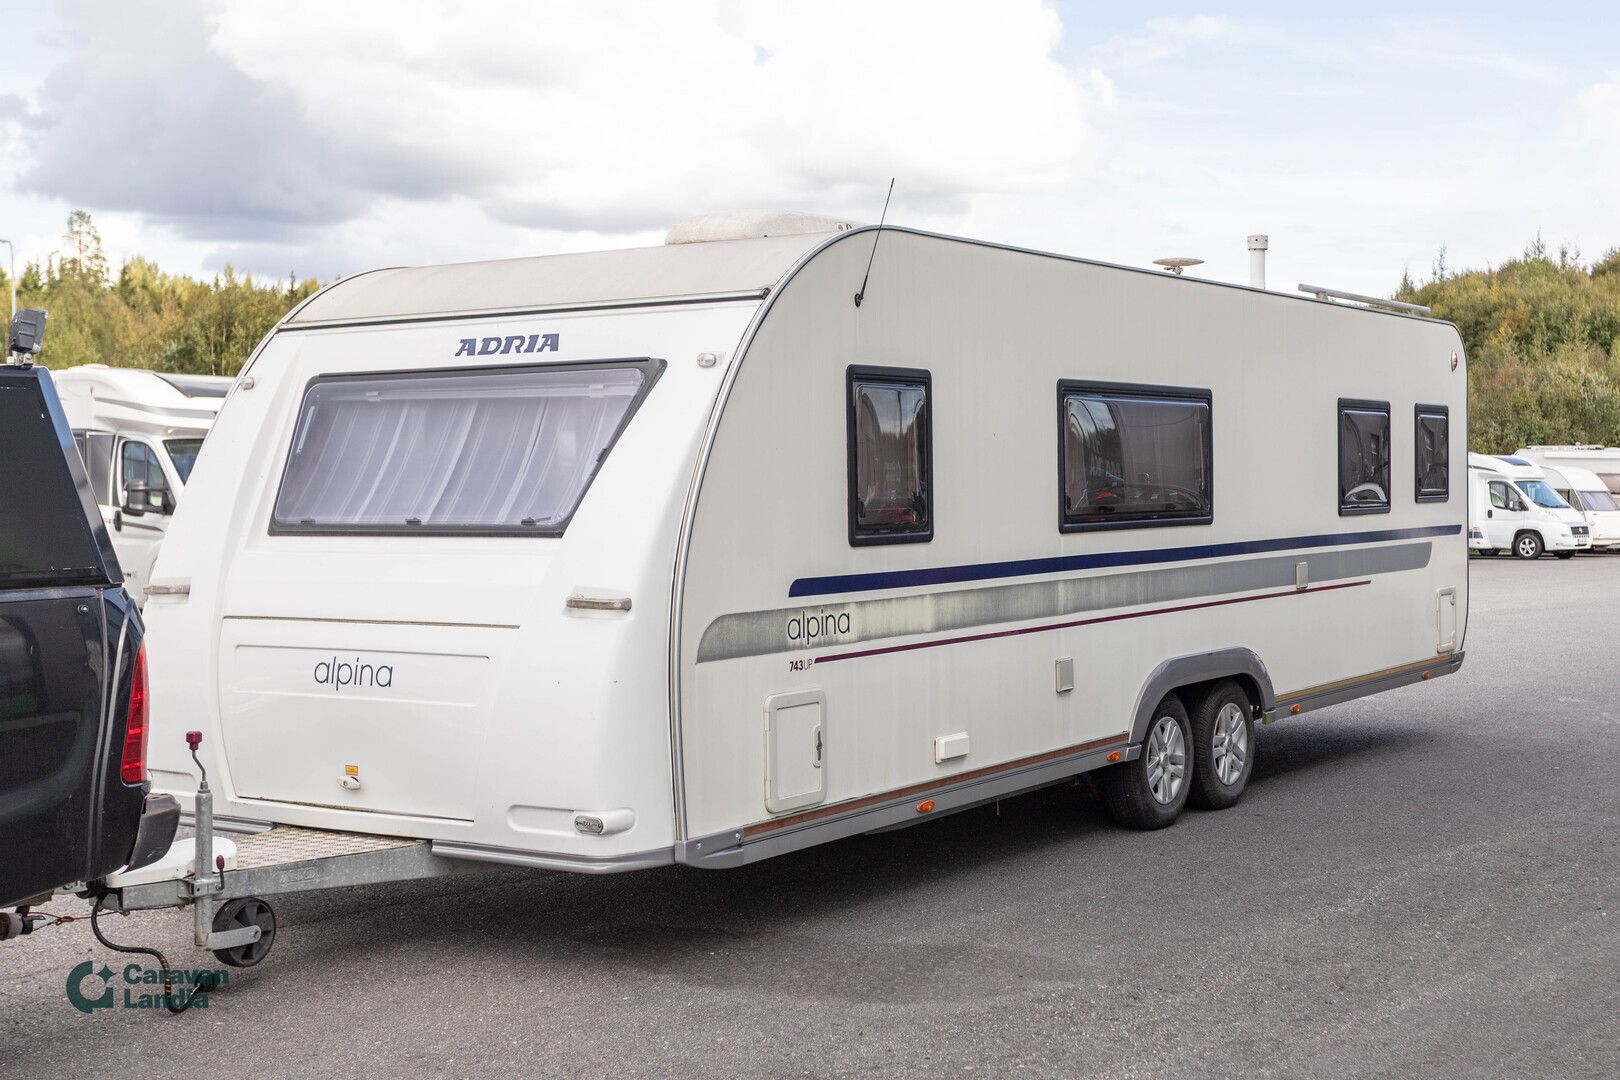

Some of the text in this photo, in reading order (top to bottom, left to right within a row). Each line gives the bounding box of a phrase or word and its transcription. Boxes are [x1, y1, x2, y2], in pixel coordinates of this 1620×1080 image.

[454, 333, 560, 357] ADRIA
[786, 608, 850, 645] alpina
[313, 655, 393, 691] alpina
